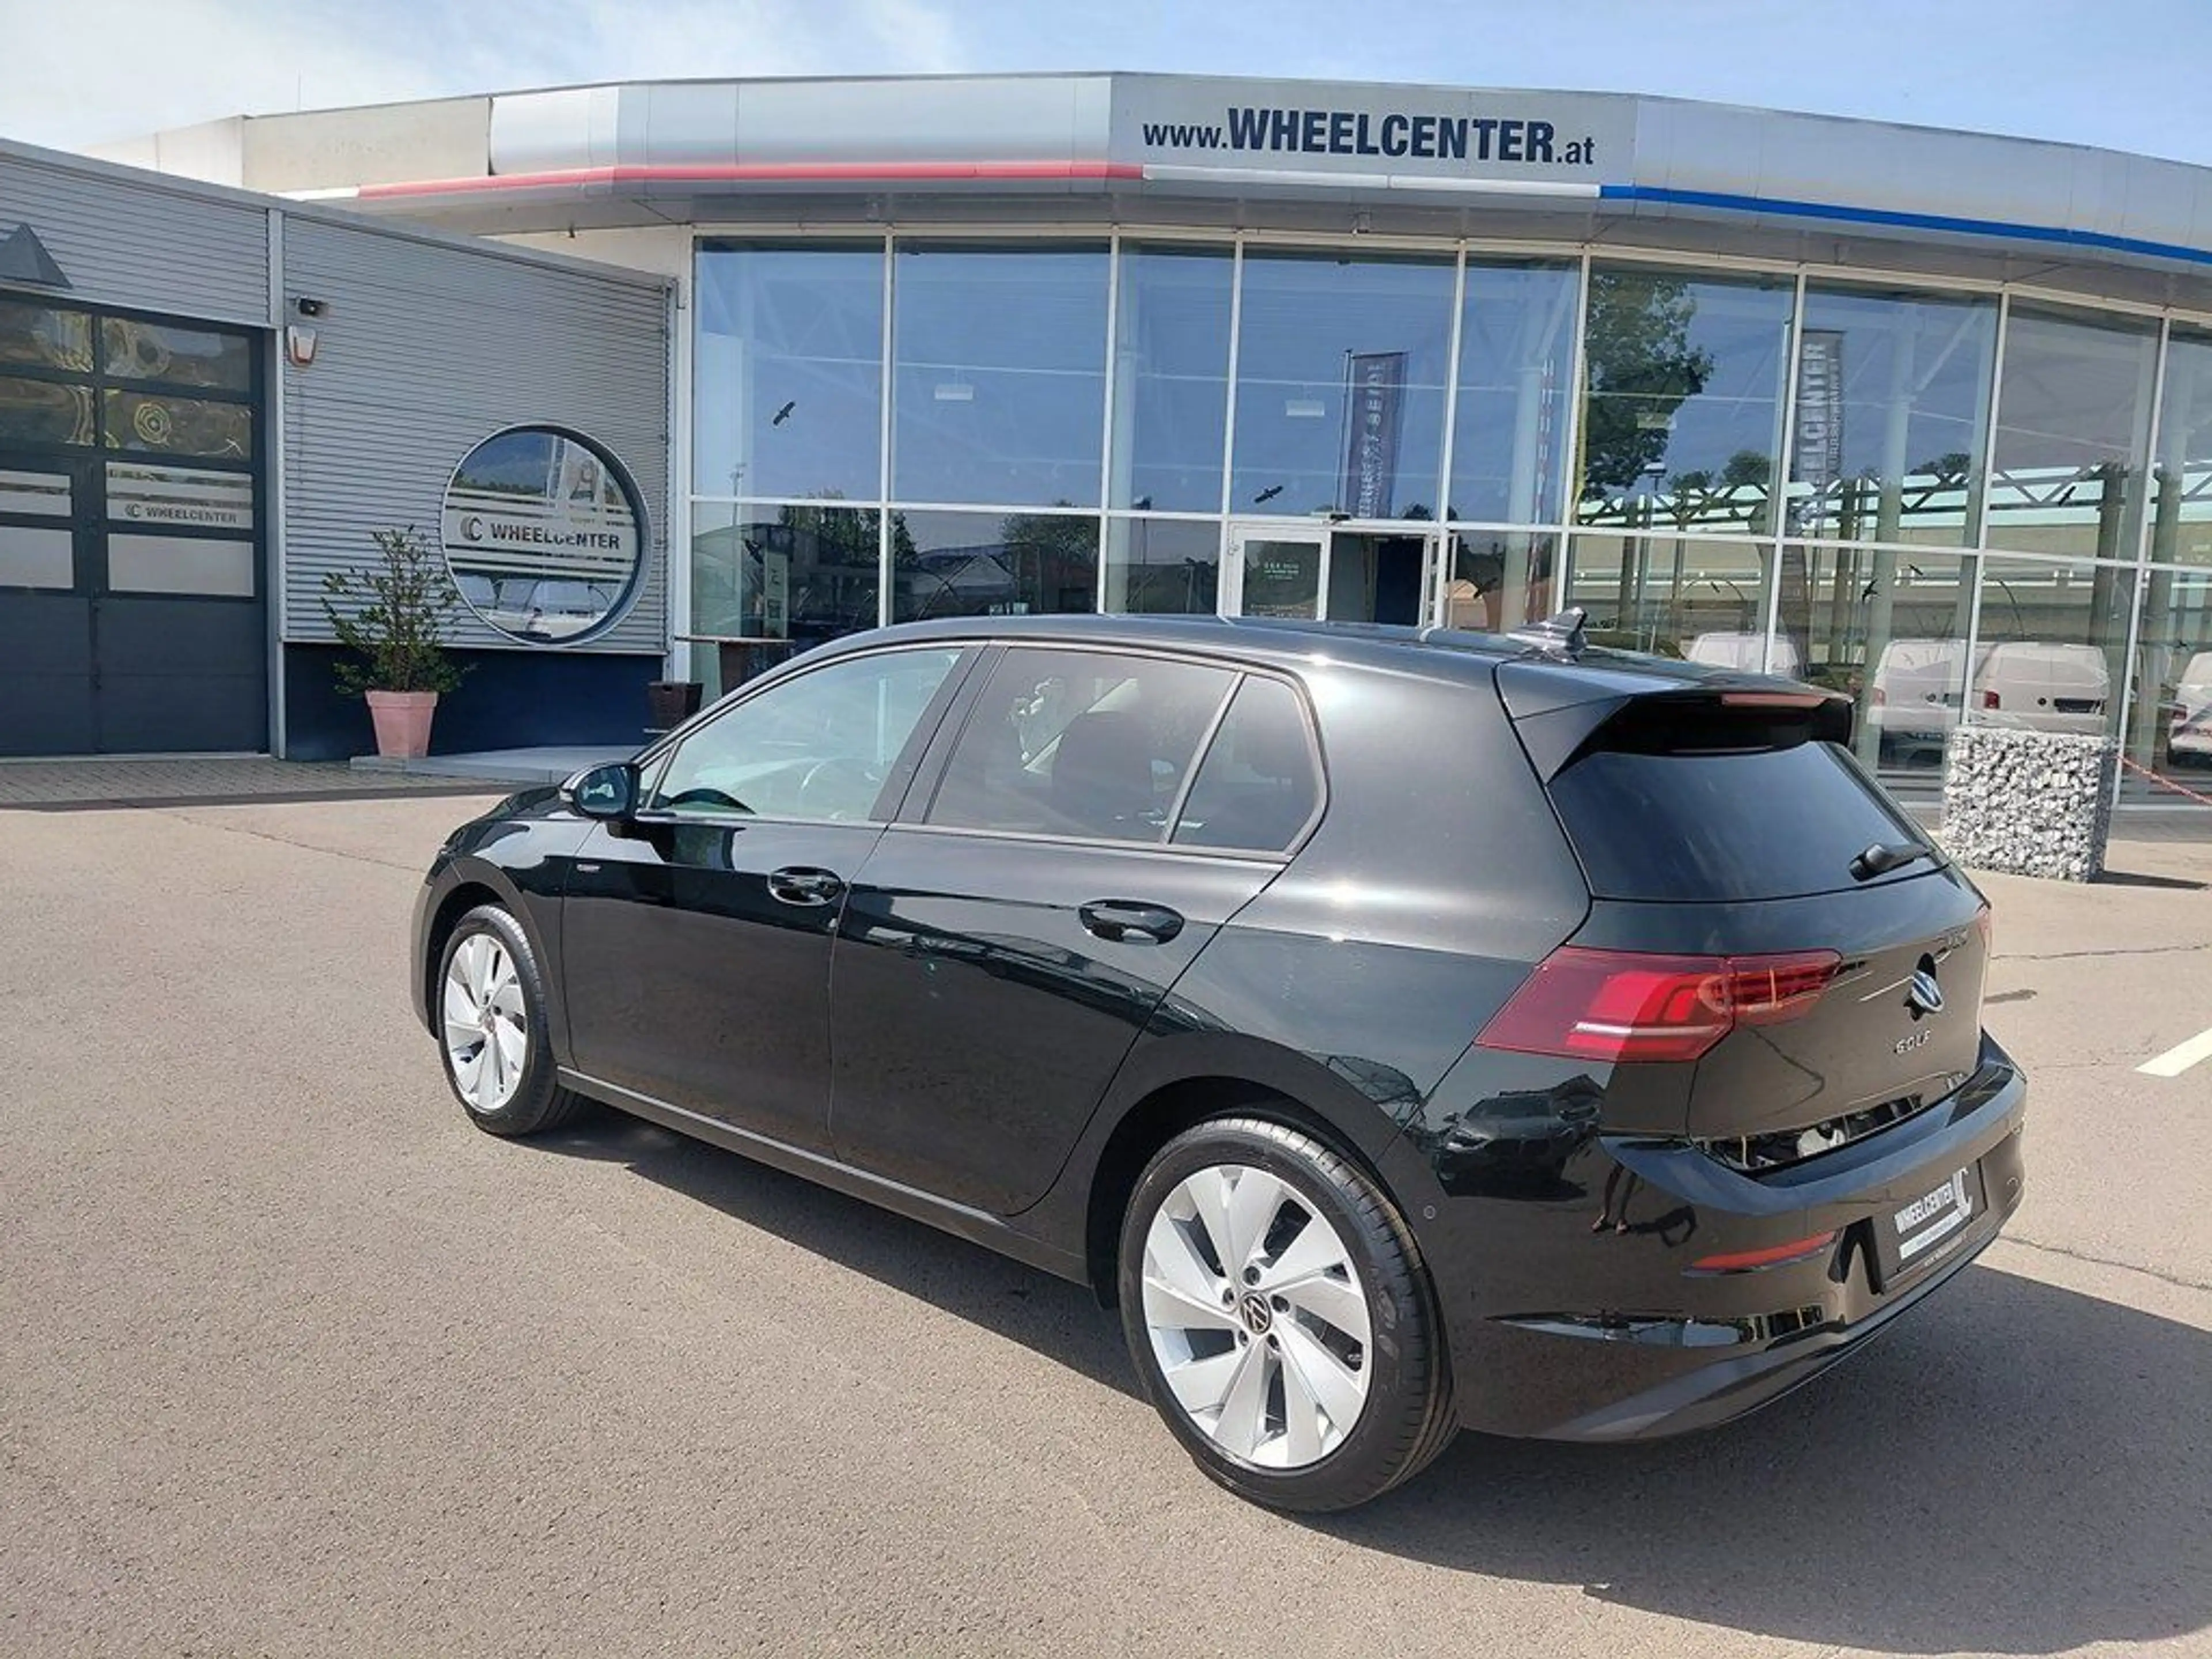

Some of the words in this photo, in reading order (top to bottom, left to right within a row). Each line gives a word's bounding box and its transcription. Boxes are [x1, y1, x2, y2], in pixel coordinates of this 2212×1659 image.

[1142, 107, 1595, 165] www.WHEELCENTER.at
[145, 507, 237, 523] WHEELCENTER
[490, 522, 620, 550] WHEELCENTER
[1895, 1029, 1931, 1054] GOLF
[1894, 1181, 1955, 1234] WHEELCENTER
